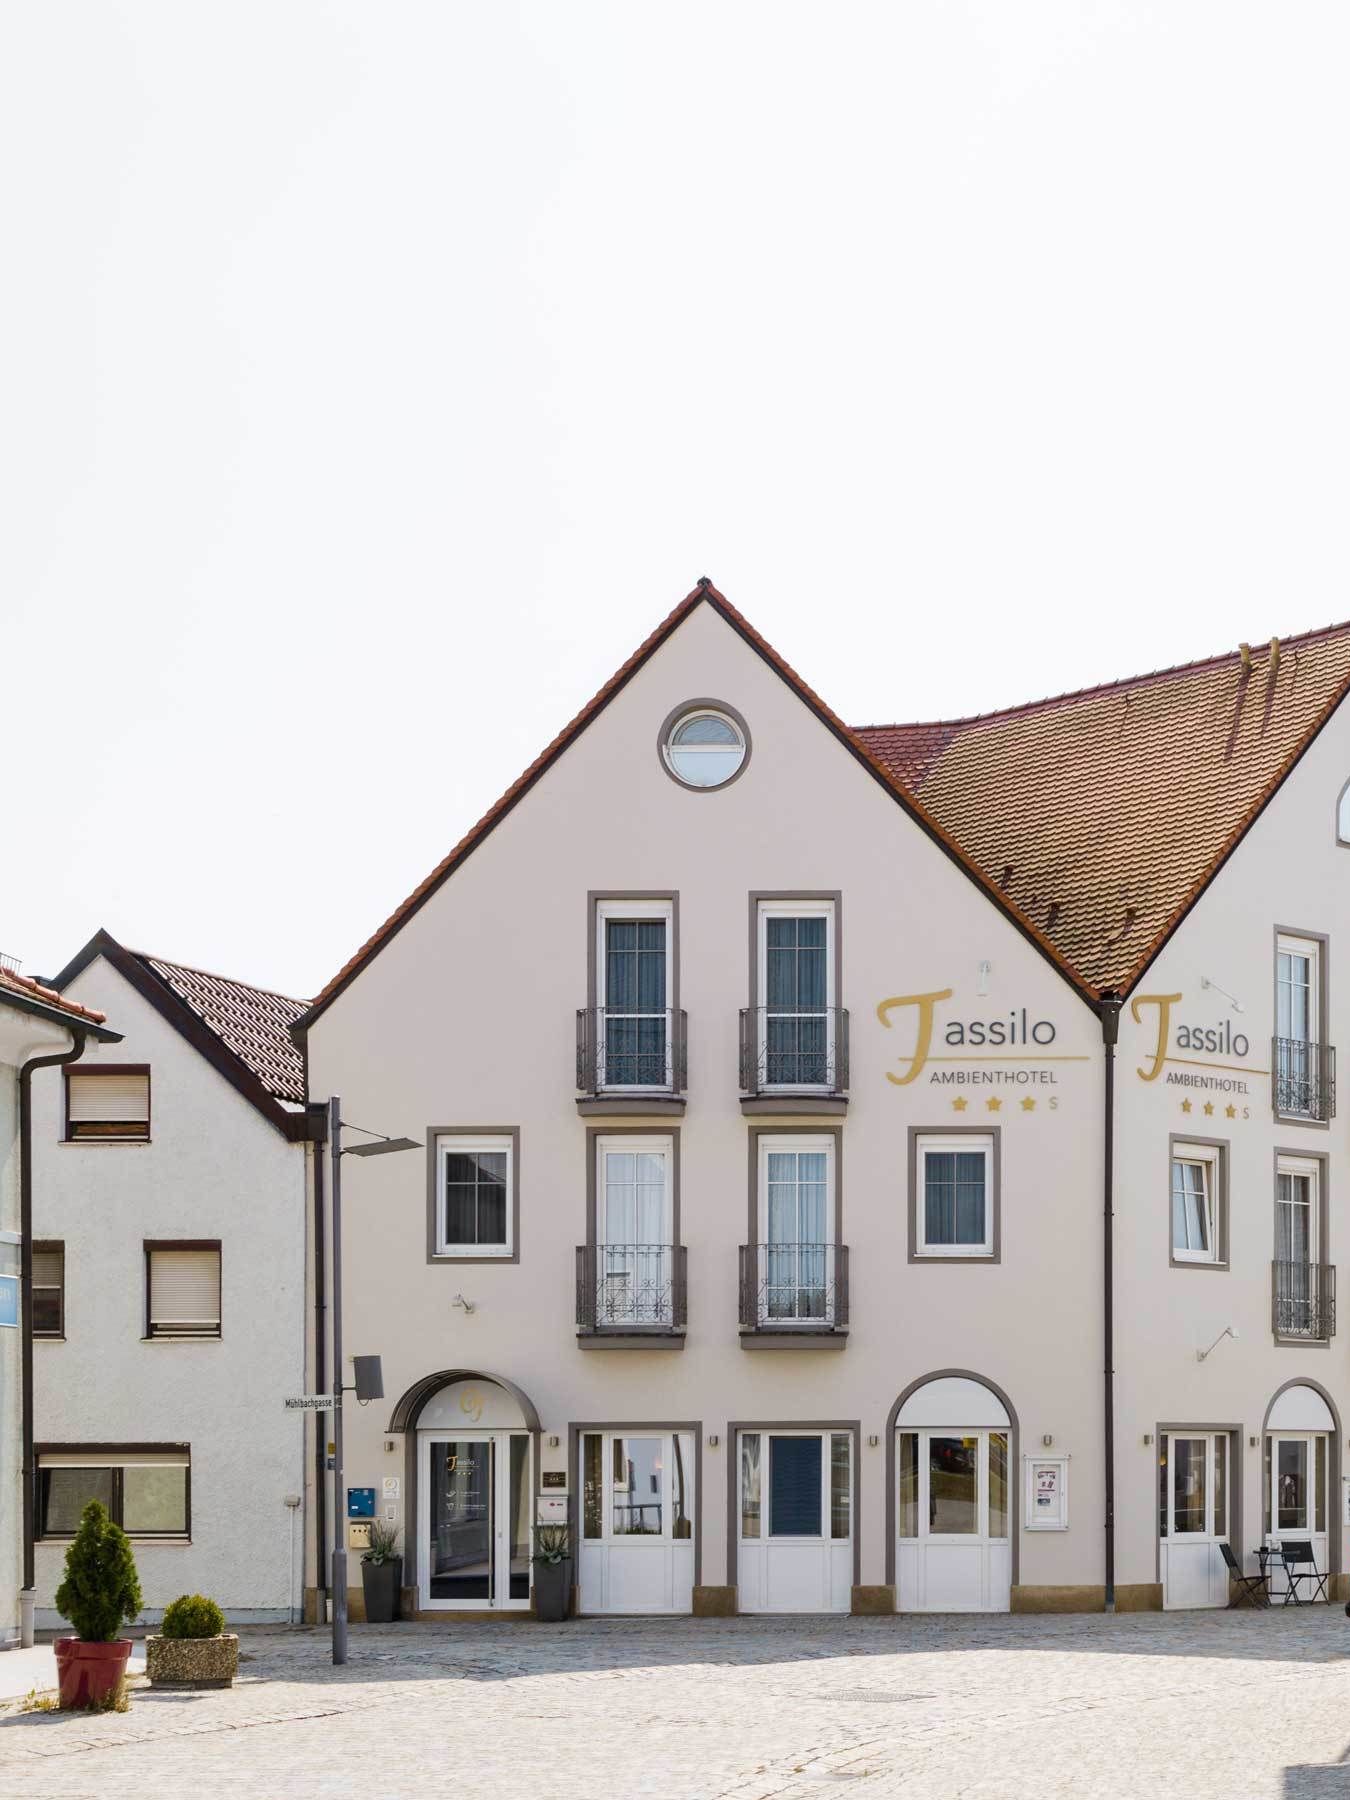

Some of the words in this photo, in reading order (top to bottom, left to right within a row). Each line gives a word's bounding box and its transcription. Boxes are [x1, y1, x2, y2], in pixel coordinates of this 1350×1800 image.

[876, 988, 1057, 1086] Tassilo
[1131, 992, 1249, 1082] Tassilo
[929, 1070, 1058, 1085] AMBIENTHOTEL
[1166, 1072, 1249, 1095] AMBIENTHOTEL
[284, 1398, 332, 1410] Mühlbachgasse
